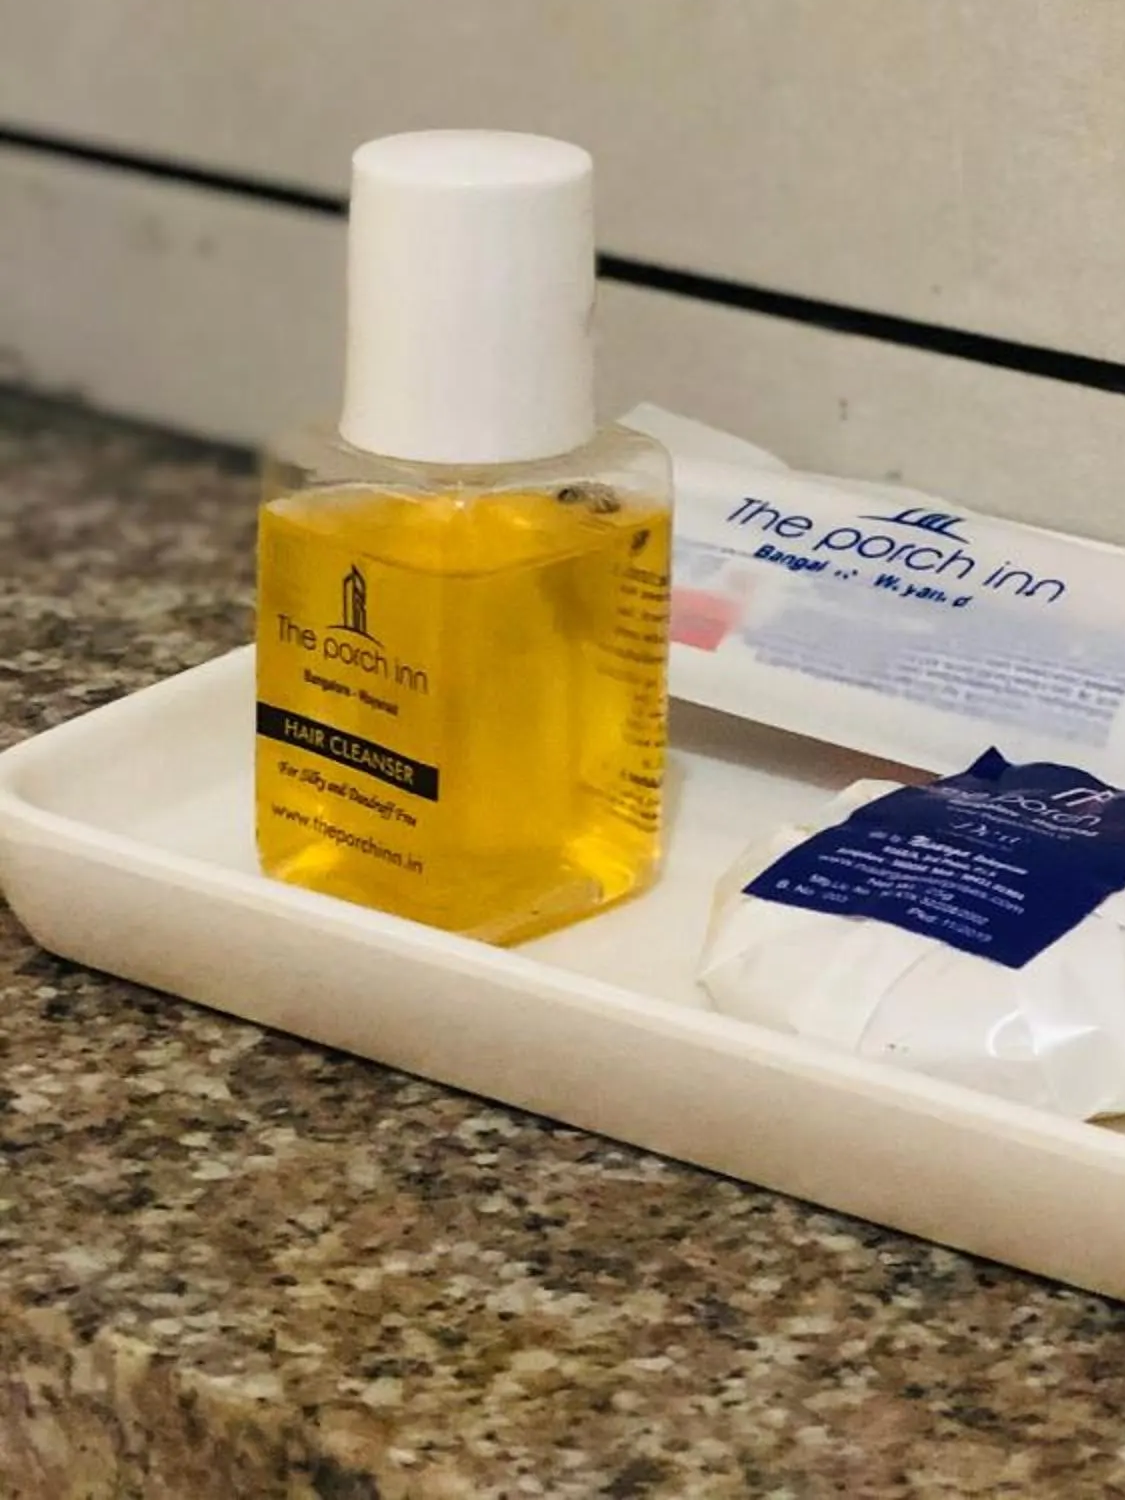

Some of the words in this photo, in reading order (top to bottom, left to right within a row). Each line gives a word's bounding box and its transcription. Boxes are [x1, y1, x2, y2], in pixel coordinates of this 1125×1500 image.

[726, 497, 813, 539] The
[812, 527, 976, 580] porch
[982, 560, 1067, 603] inn
[277, 613, 317, 650] The
[323, 637, 388, 679] porch
[395, 657, 429, 695] inn
[284, 718, 325, 749] HAIR
[329, 736, 415, 786] CLEANSER
